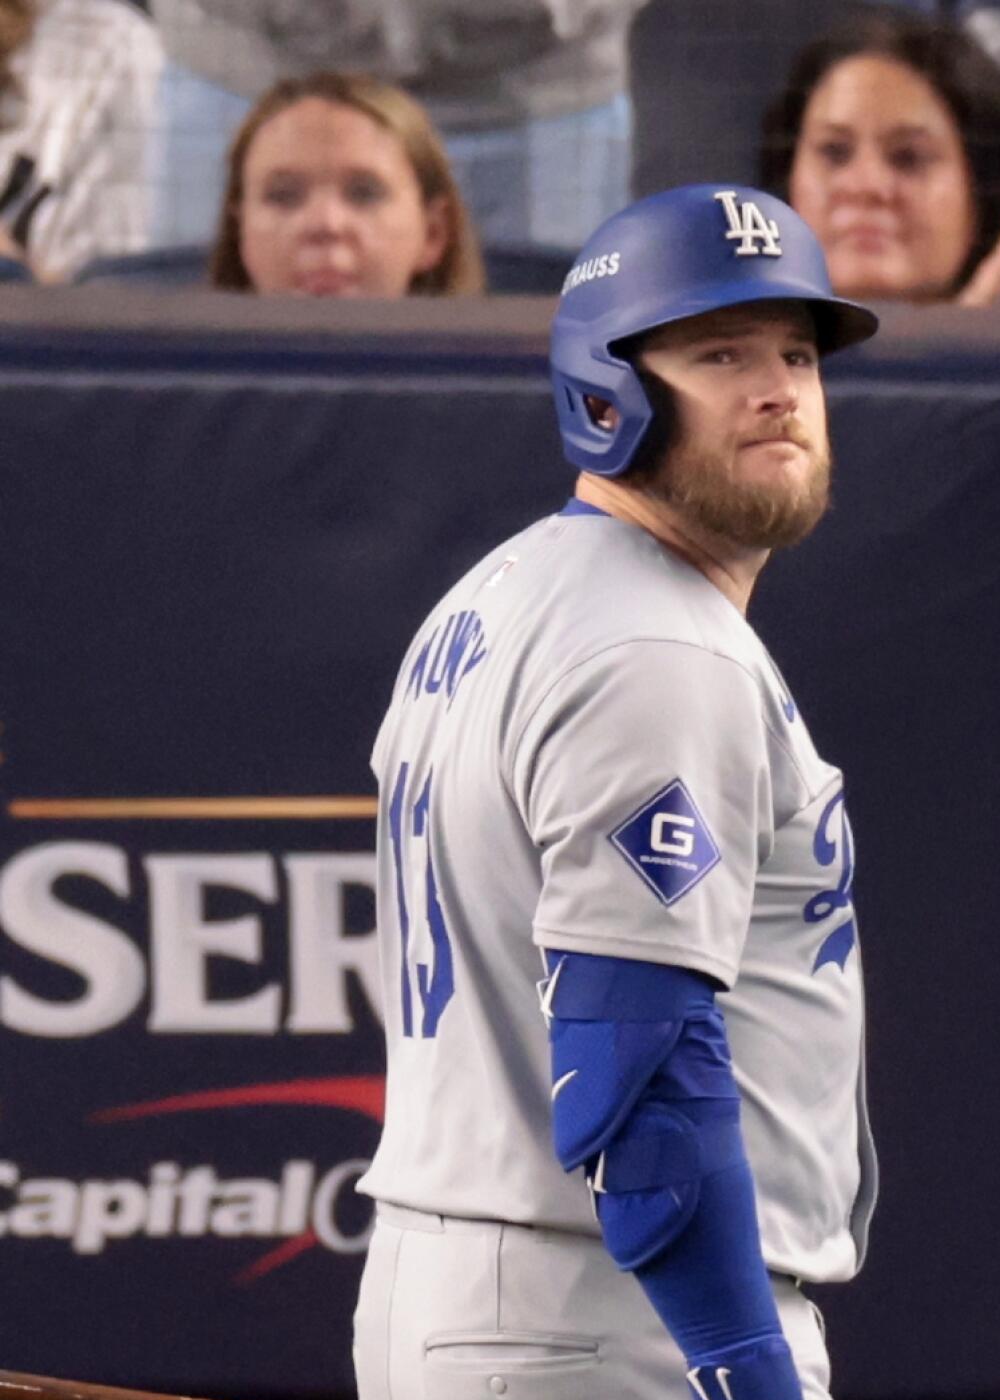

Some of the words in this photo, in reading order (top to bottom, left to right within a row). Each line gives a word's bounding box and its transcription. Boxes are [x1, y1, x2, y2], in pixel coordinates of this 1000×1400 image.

[714, 190, 782, 257] LA
[650, 811, 696, 857] G
[389, 761, 455, 1039] 13
